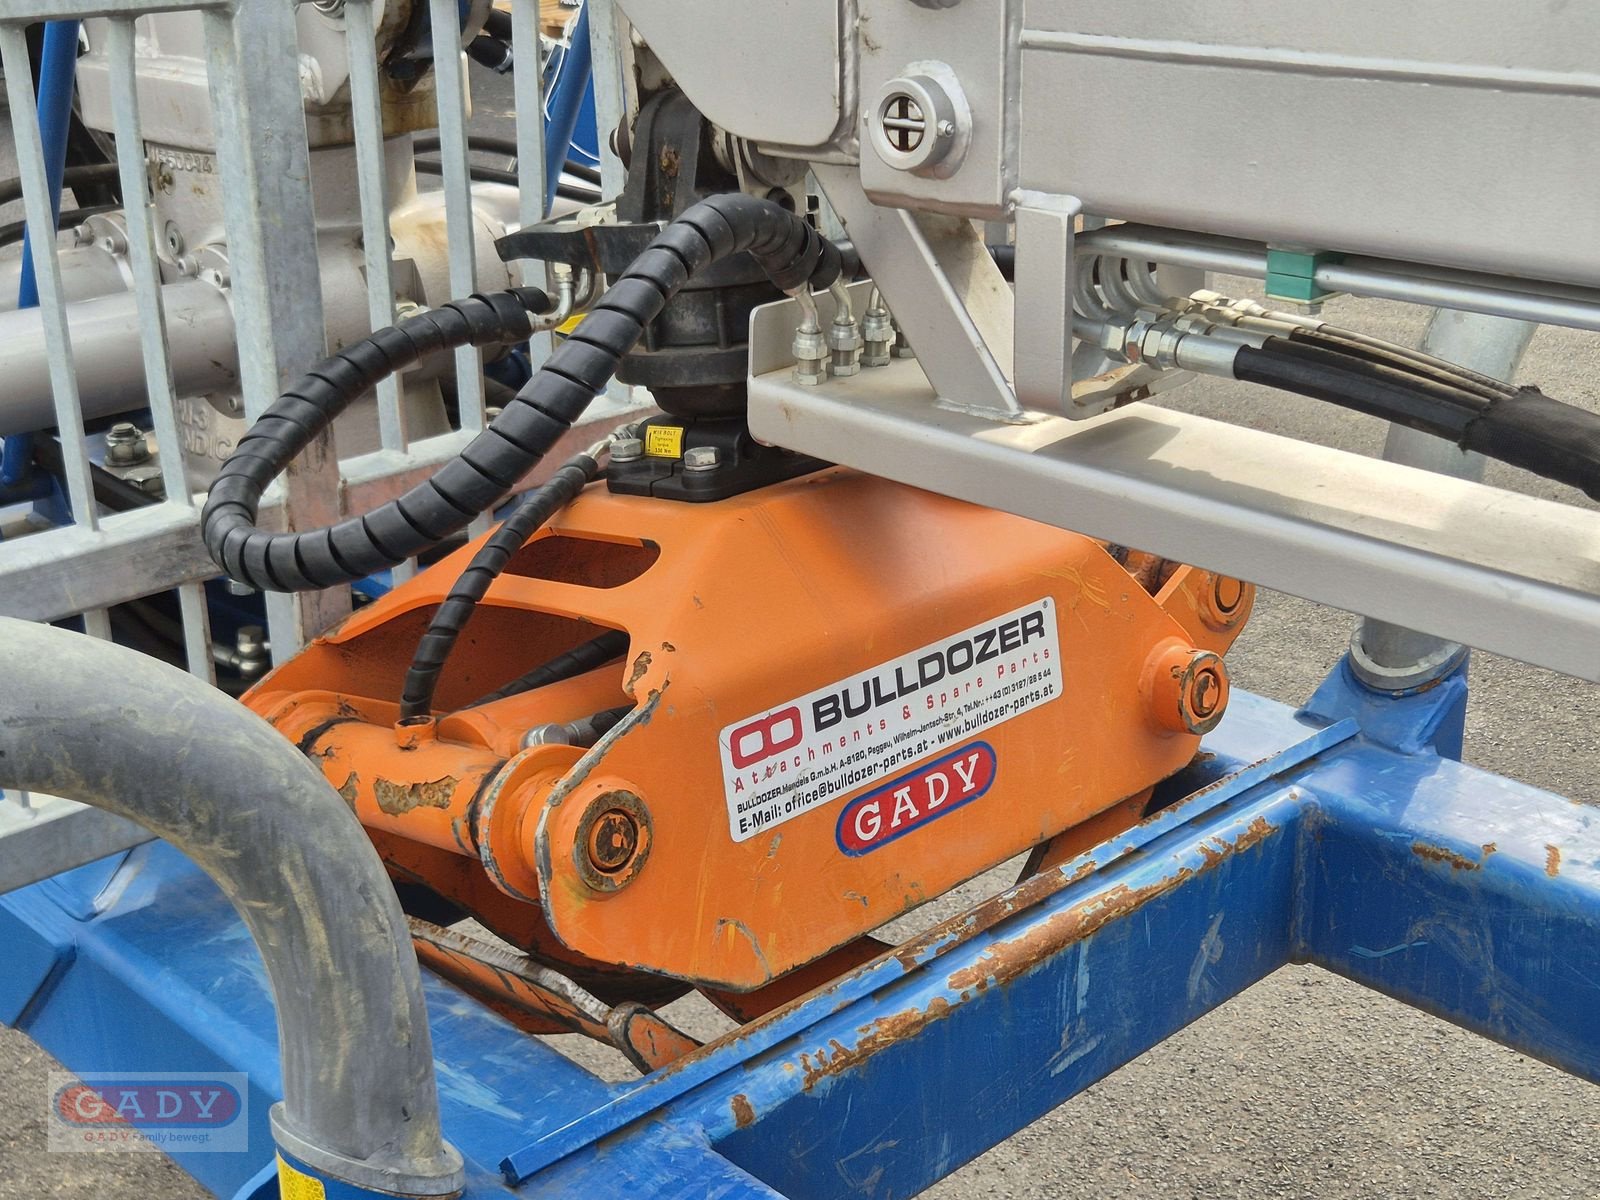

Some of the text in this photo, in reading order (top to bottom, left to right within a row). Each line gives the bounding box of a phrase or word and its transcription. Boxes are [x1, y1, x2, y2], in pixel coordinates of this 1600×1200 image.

[734, 648, 1050, 793] Attachments & Spare Parts
[739, 804, 782, 835] E-Mail:
[785, 738, 929, 815] office@bulldozer-parts.at
[937, 683, 1054, 744] www.bulldozer-parts.at
[868, 740, 893, 757] Peggau,
[1043, 667, 1052, 679] 44
[854, 752, 980, 841] GADY
